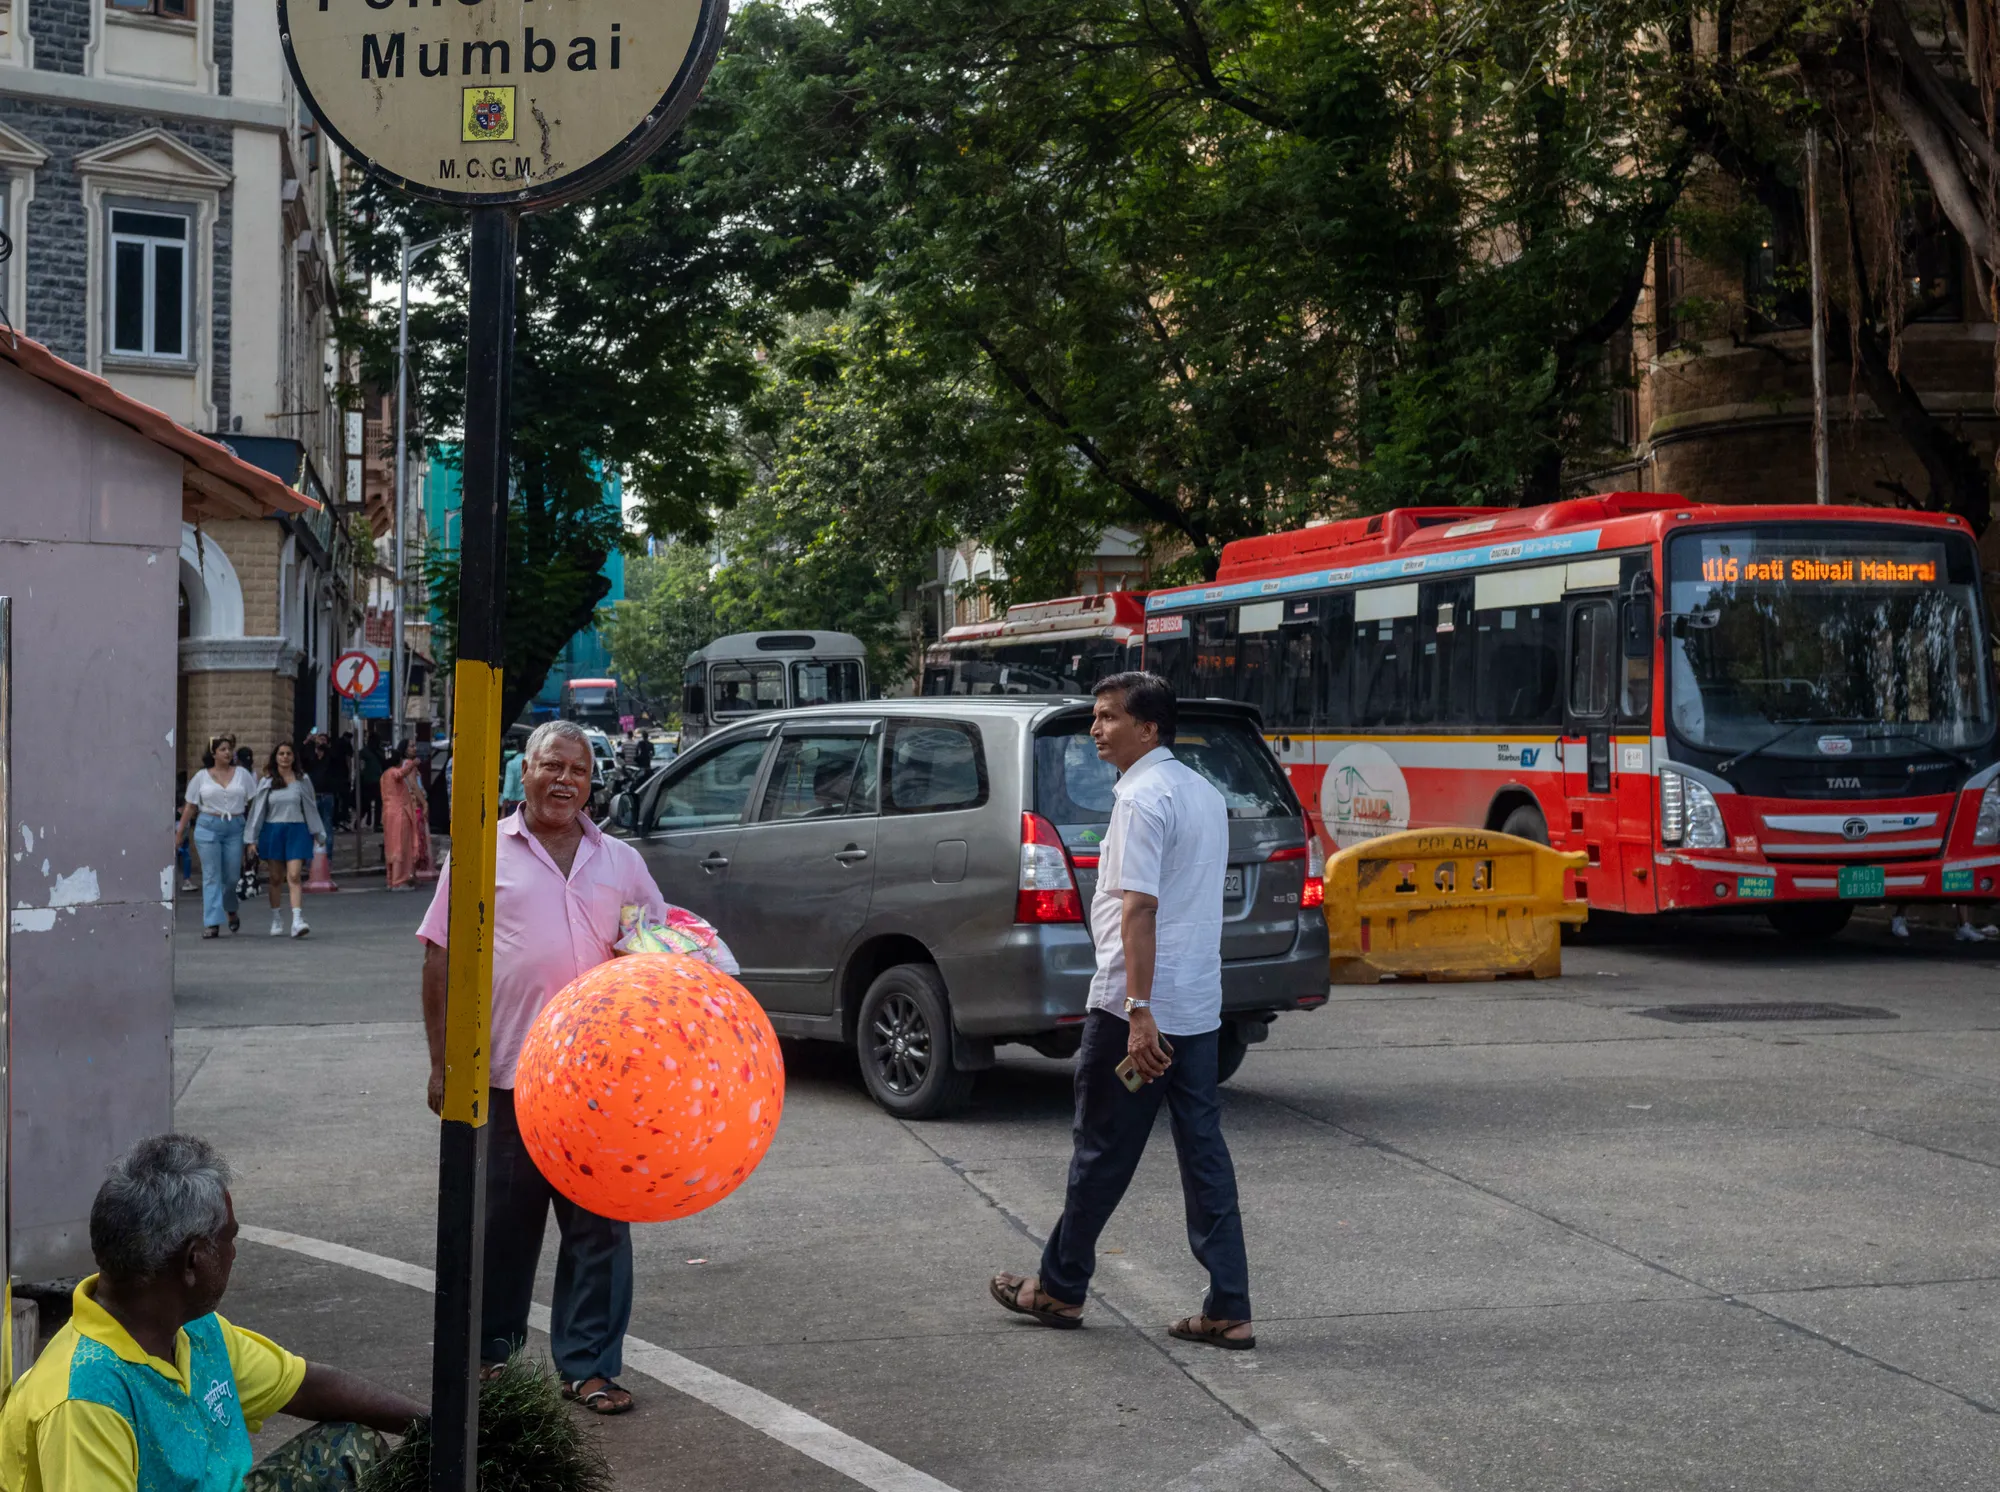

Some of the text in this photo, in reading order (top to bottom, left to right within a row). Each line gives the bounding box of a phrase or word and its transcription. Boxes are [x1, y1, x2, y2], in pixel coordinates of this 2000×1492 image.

[361, 23, 621, 79] Mumbai
[1791, 560, 1853, 581] Shivaji
[1147, 616, 1182, 633] ZERO EMISSION
[1827, 778, 1861, 788] TATA
[1743, 879, 1768, 887] MH-01
[1739, 888, 1772, 897] DR-3057
